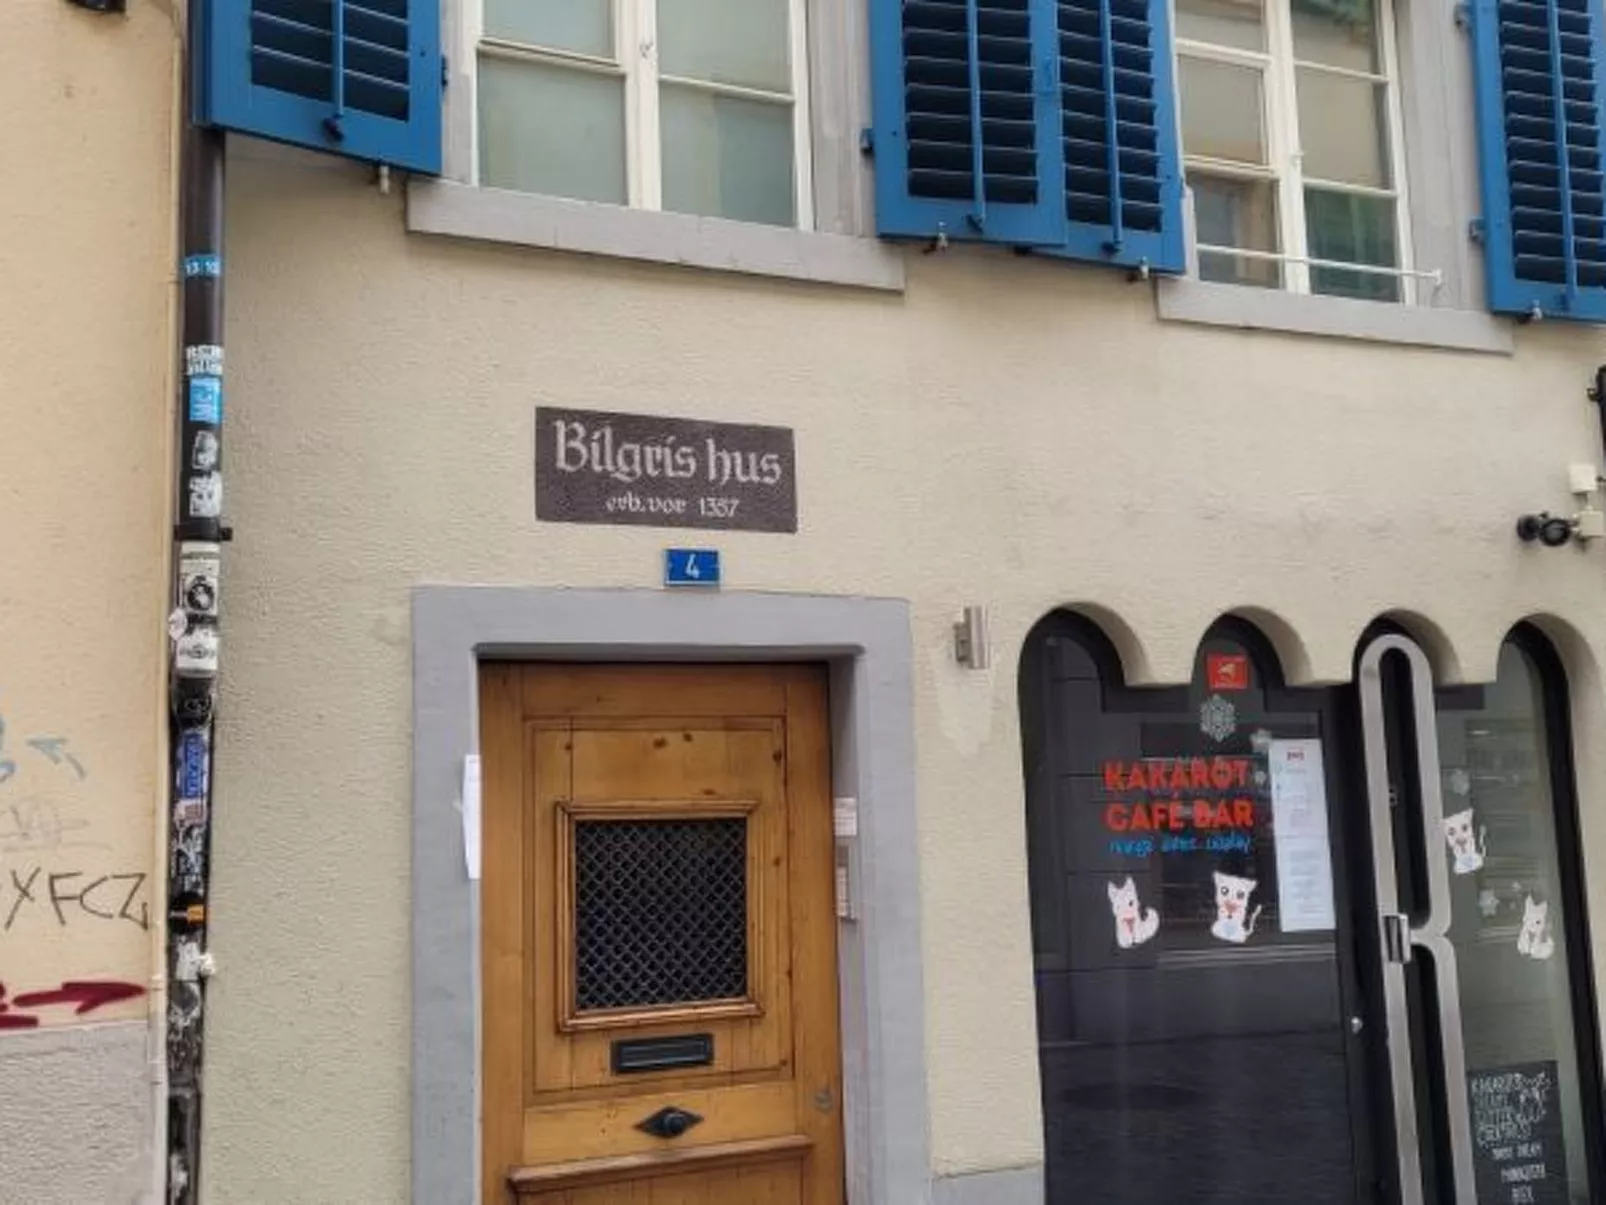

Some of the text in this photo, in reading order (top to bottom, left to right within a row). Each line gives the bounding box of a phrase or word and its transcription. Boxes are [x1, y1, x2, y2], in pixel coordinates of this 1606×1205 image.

[553, 419, 782, 486] Bilgris hus
[684, 552, 701, 579] 4
[1104, 757, 1249, 790] KAKAROT
[1191, 797, 1255, 830] BAR
